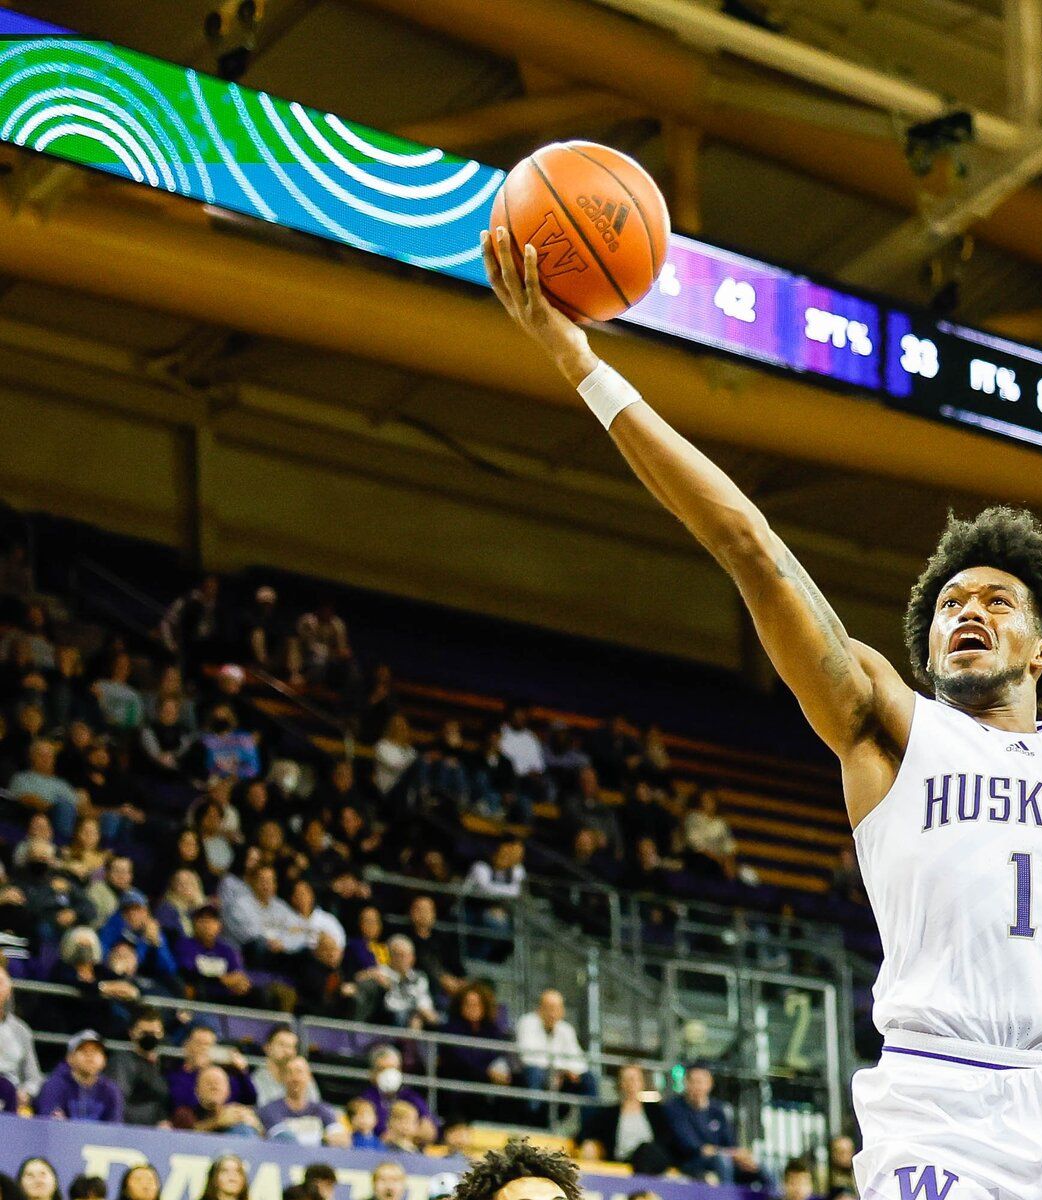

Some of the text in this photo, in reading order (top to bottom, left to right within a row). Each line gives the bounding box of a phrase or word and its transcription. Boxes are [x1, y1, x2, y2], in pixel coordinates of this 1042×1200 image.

[524, 211, 588, 278] W
[576, 195, 620, 253] adidas
[1007, 851, 1038, 940] 1
